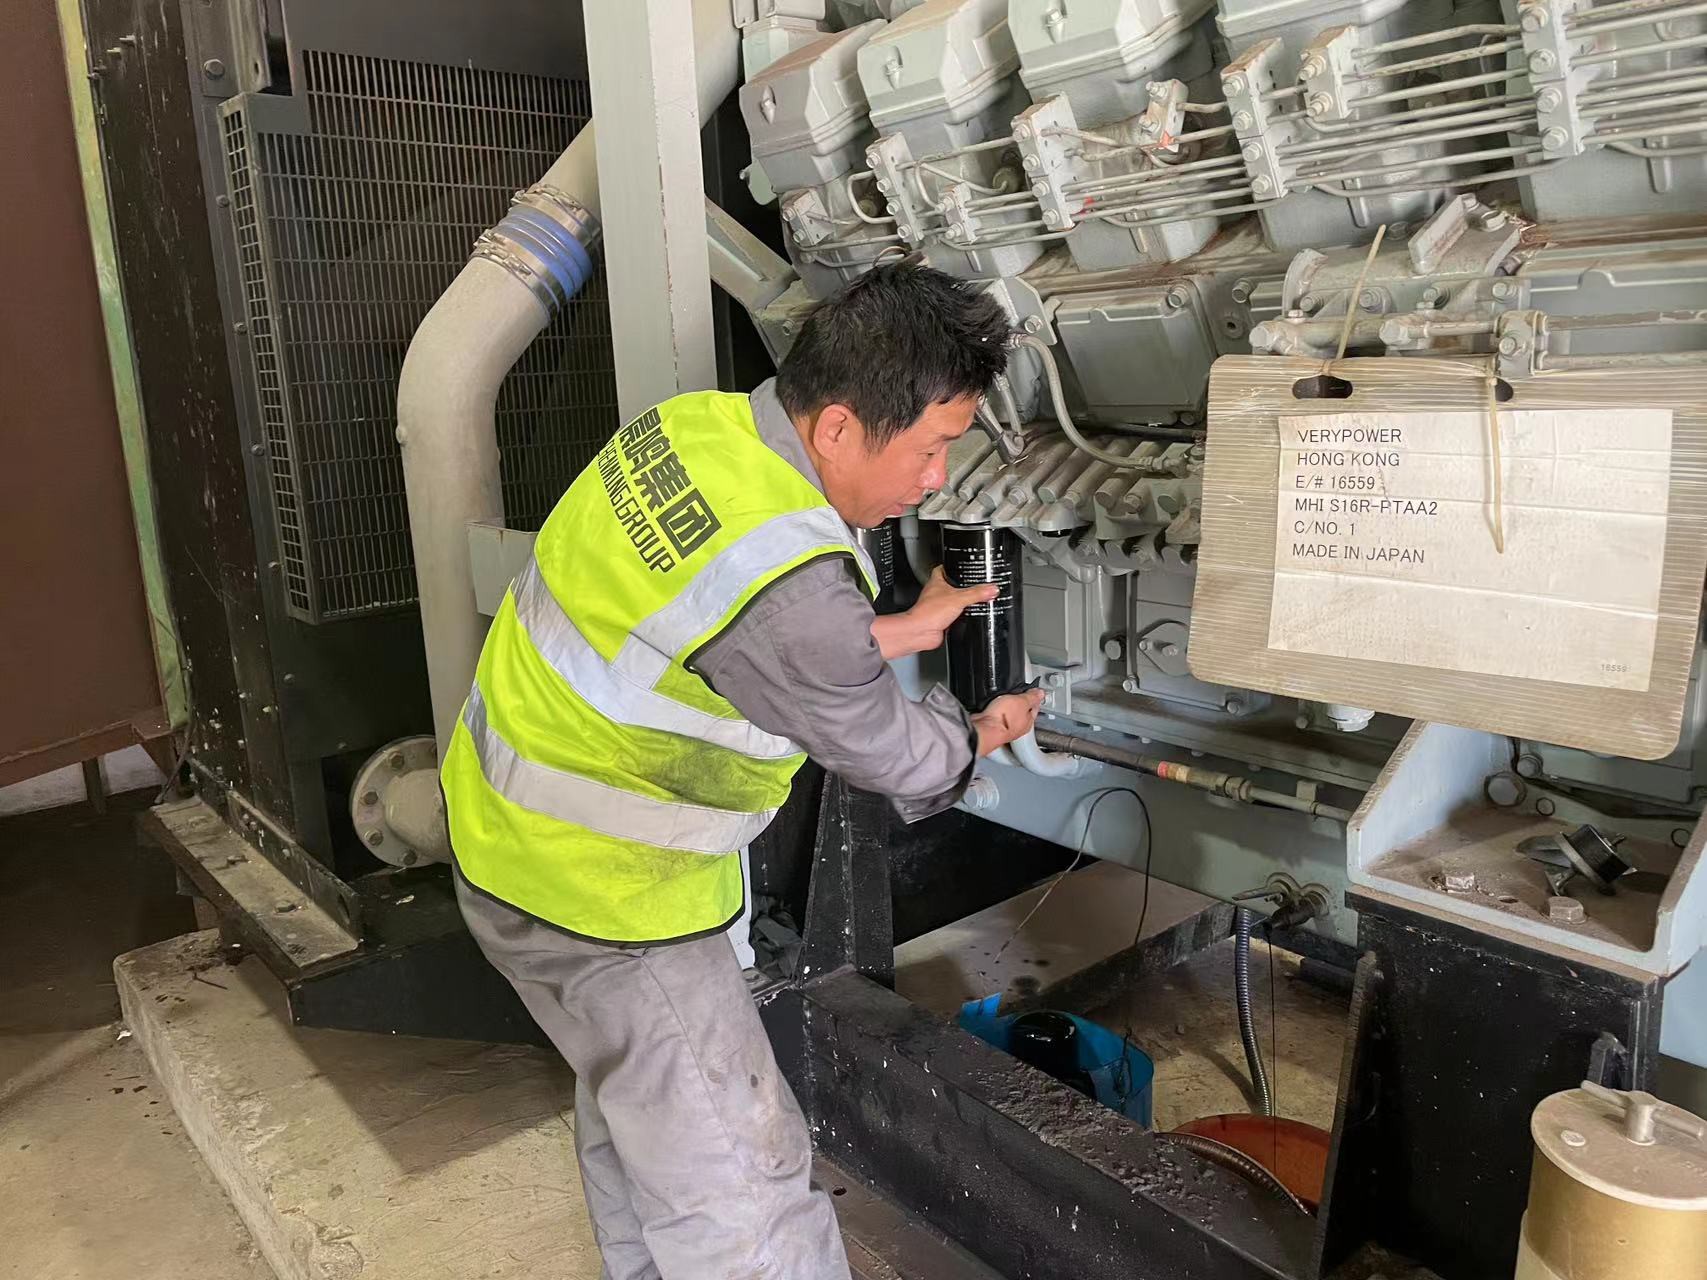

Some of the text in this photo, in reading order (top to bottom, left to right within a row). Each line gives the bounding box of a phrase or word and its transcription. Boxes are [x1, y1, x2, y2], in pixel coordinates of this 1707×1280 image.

[1298, 429, 1402, 443] VERYPOWER
[1297, 452, 1400, 467] HONG KONG
[1295, 475, 1375, 490] E/# 16559
[1295, 498, 1438, 516] MHI S16R-PTAA2
[615, 496, 676, 573] GROUP
[1294, 520, 1355, 536] C/NO. 1
[1292, 543, 1425, 564] MADE IN JAPAN
